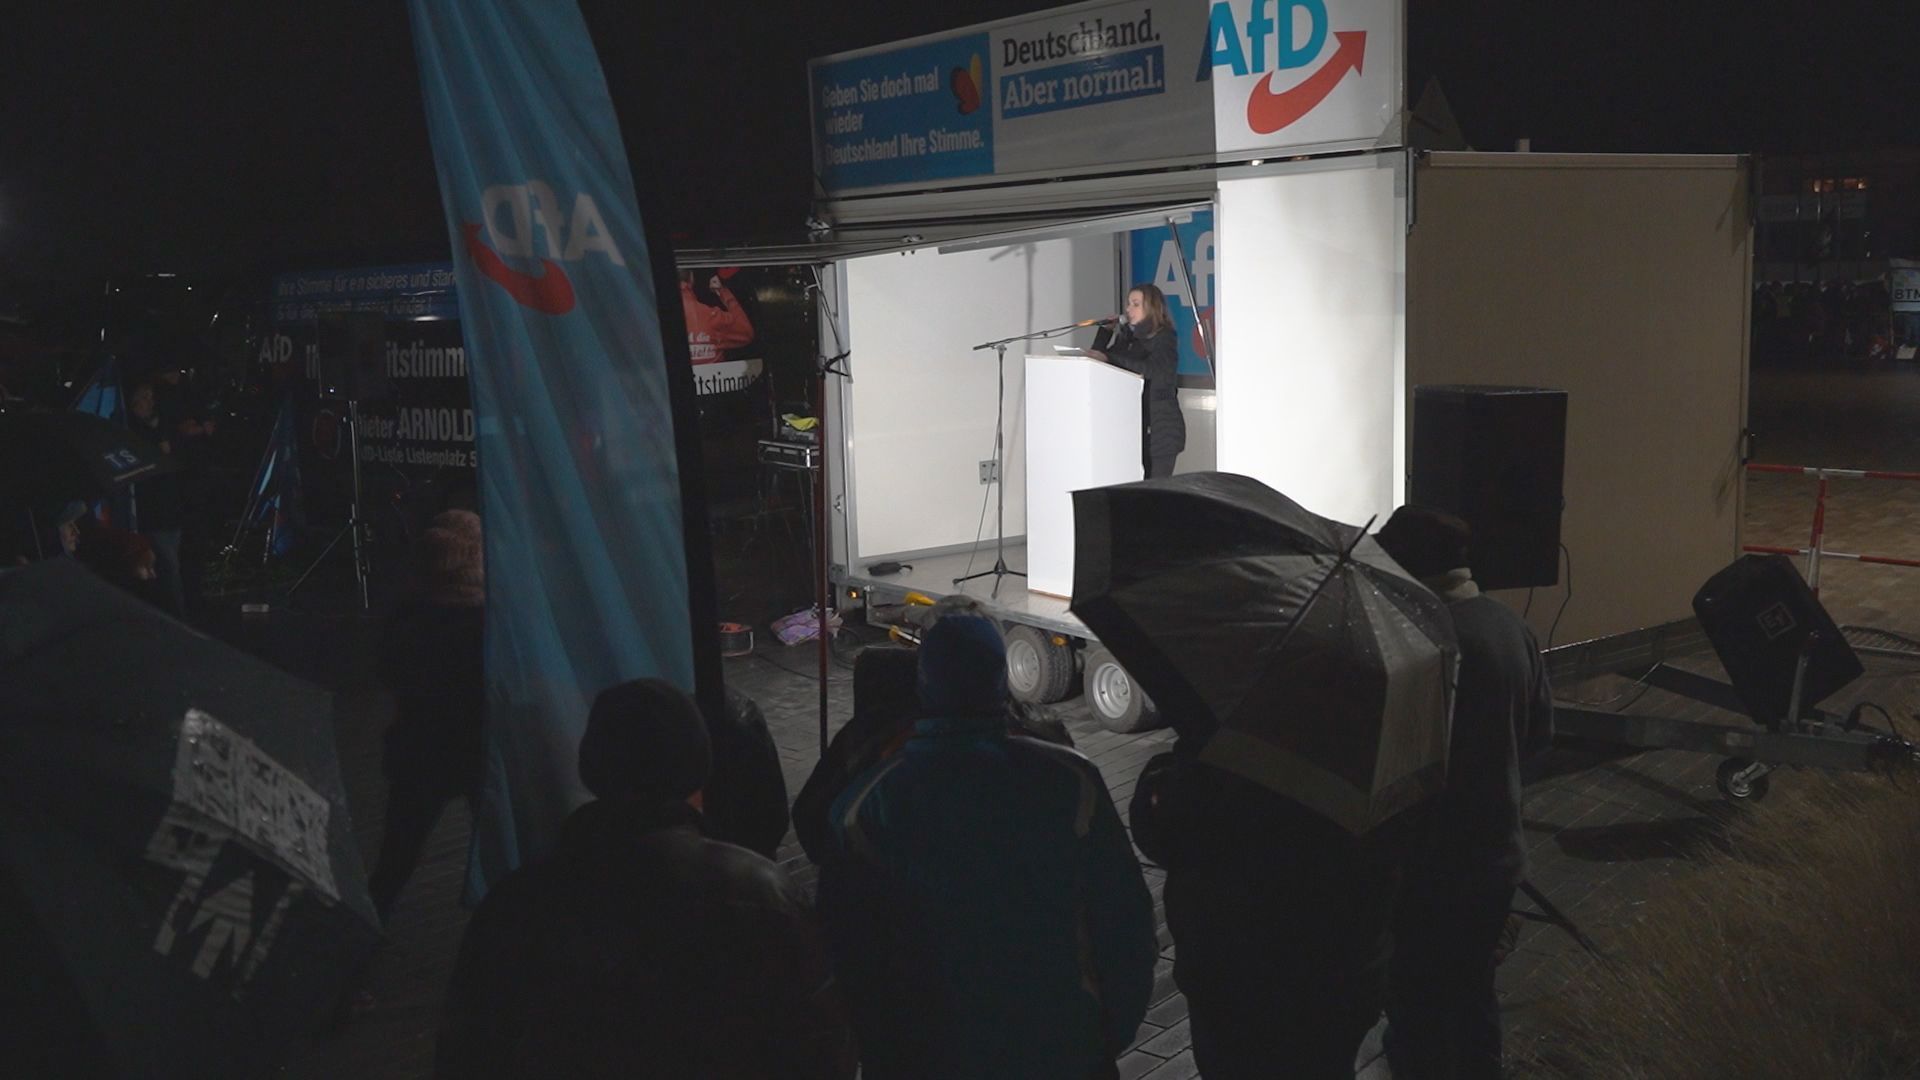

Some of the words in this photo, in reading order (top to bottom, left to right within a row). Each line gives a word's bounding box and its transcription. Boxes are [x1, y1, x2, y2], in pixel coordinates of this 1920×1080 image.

[1002, 9, 1161, 67] Deutschland.
[1195, 0, 1328, 82] AfD
[822, 81, 858, 109] Geben
[859, 78, 878, 103] Sie
[881, 72, 912, 99] doch
[914, 65, 939, 93] mal
[1003, 76, 1057, 110] Aber
[1063, 54, 1163, 101] normal.
[824, 110, 864, 135] wieder
[825, 135, 898, 166] Deutschland
[901, 132, 926, 158] Ihre
[928, 127, 985, 154] Stimme.
[259, 333, 293, 363] AfD
[397, 407, 476, 443] ARNOLD
